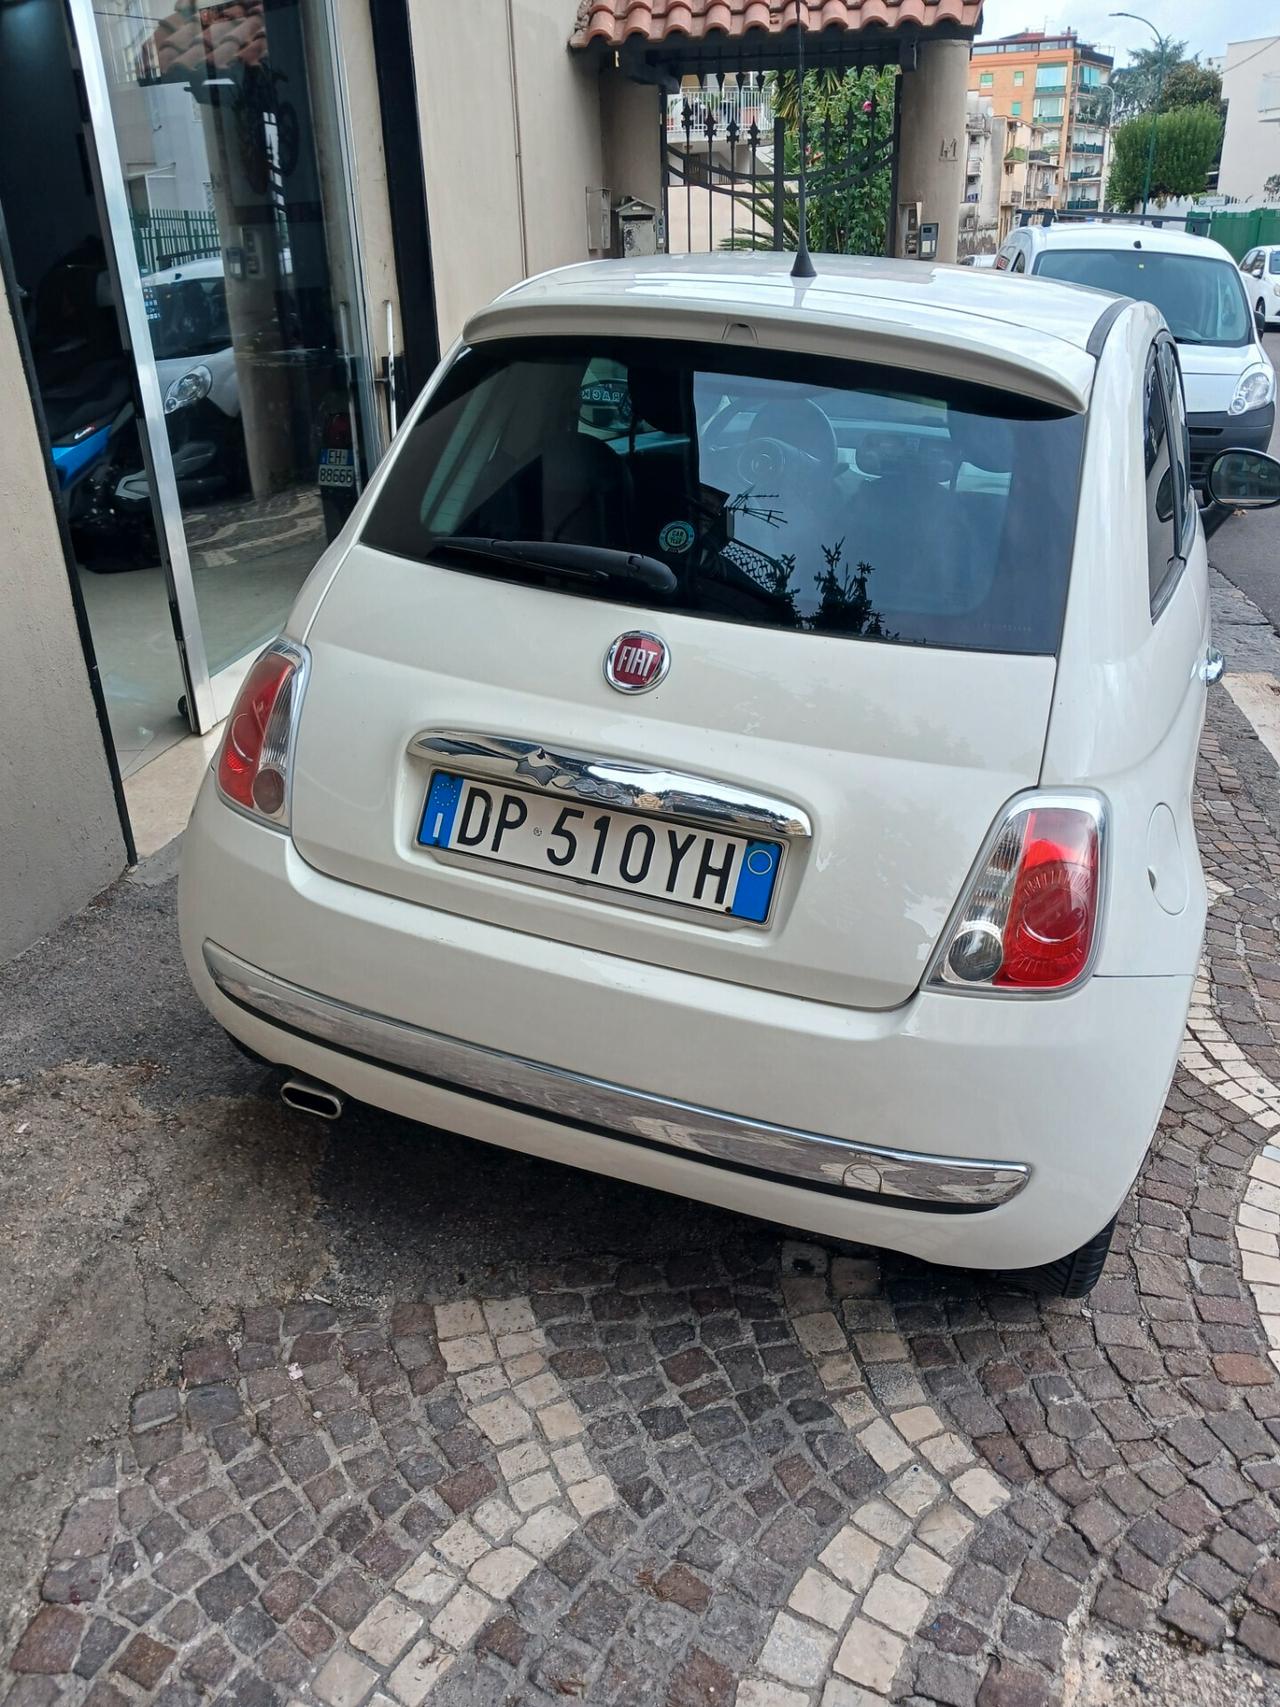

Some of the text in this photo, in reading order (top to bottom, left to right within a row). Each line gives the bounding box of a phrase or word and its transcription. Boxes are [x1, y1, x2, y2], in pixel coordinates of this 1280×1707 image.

[617, 645, 657, 677] FIAT
[456, 786, 736, 904] DP 510YH
